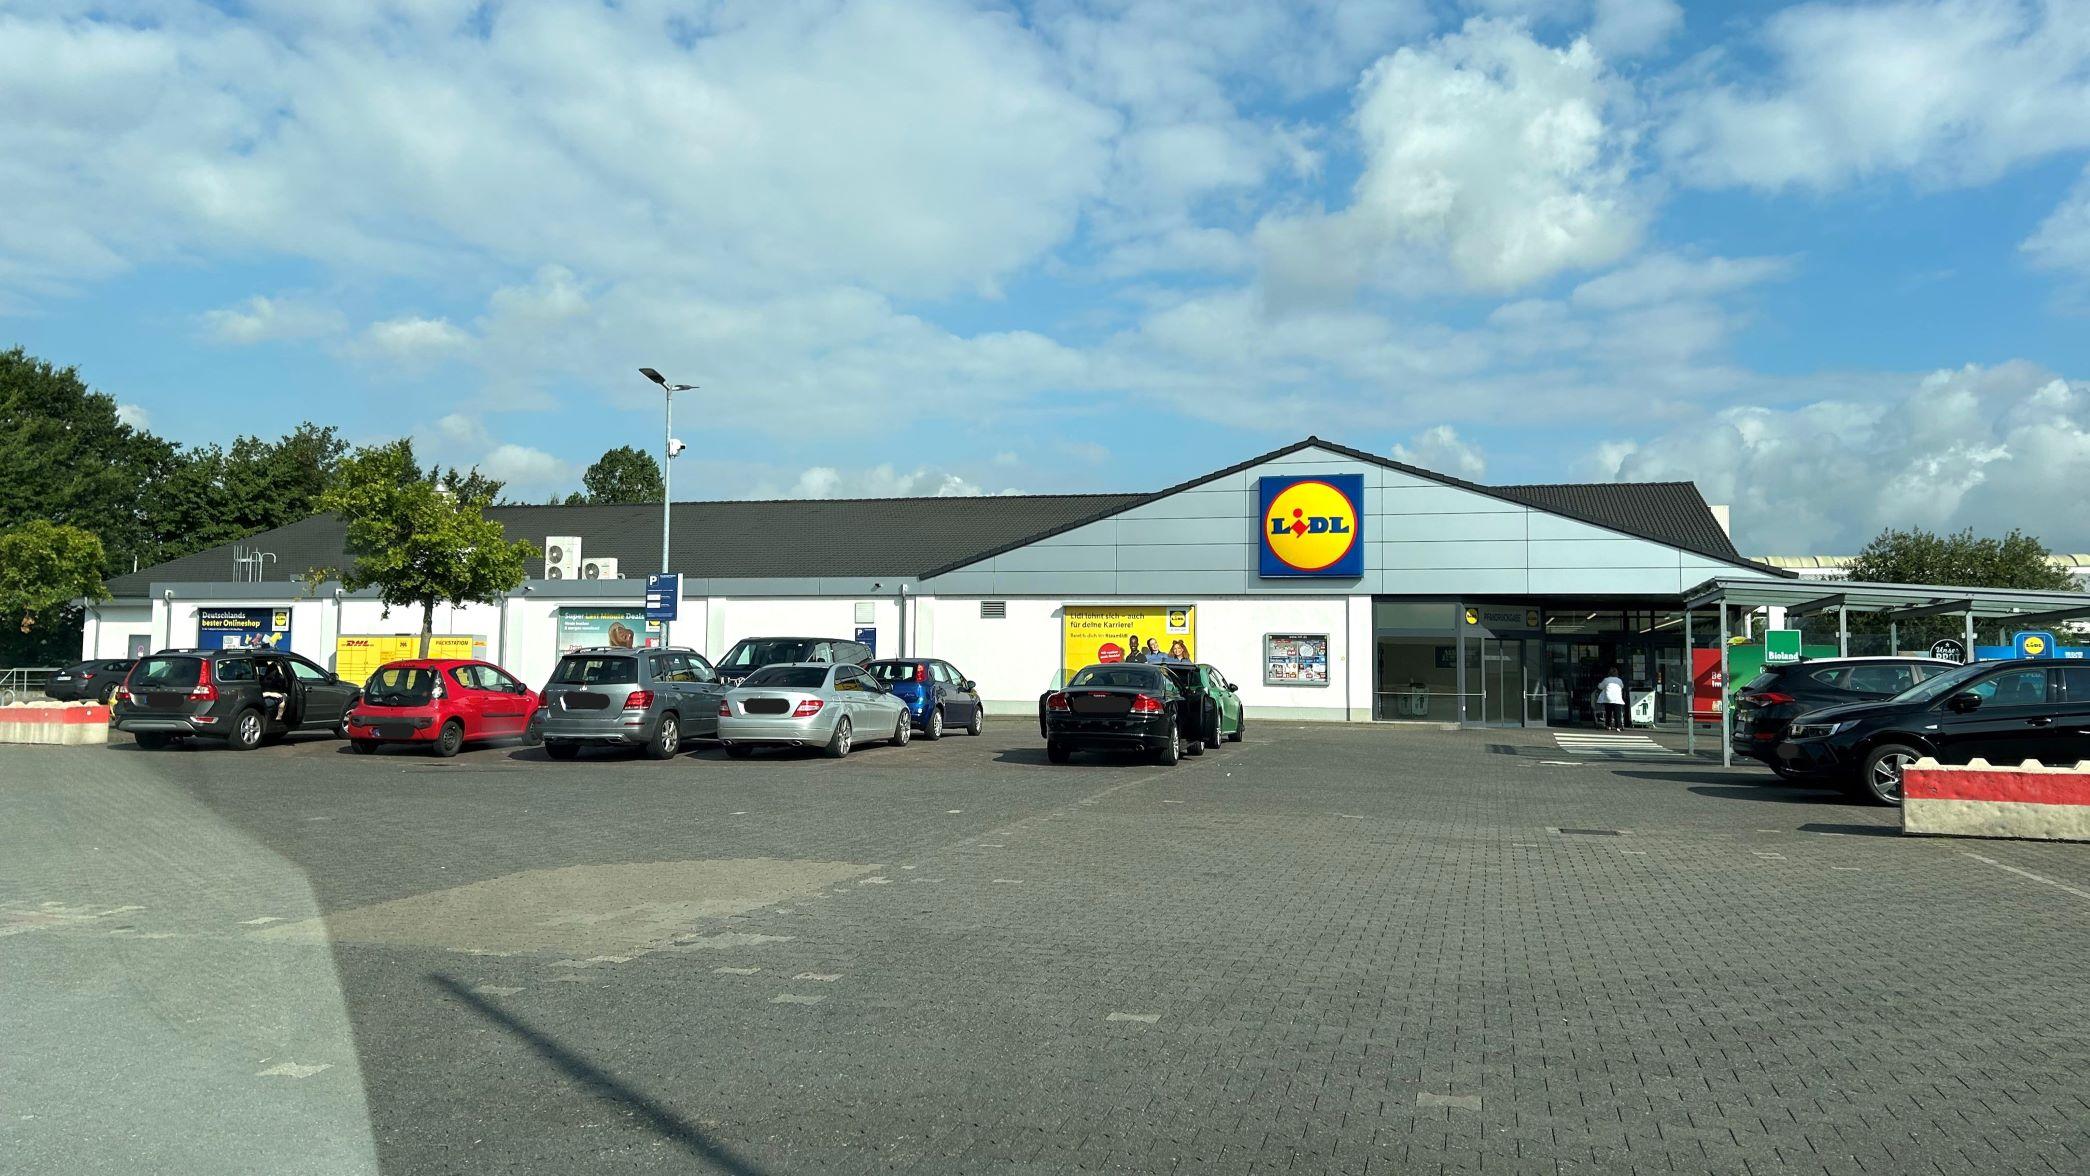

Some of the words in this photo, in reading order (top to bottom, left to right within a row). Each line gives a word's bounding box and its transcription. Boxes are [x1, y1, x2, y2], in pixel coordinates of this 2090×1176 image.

[649, 575, 658, 586] P
[564, 612, 584, 620] Super
[600, 612, 625, 620] Minute
[625, 612, 645, 620] Deals
[202, 619, 223, 627] bester
[223, 619, 260, 628] Onlineshop
[1768, 651, 1799, 660] Bioland
